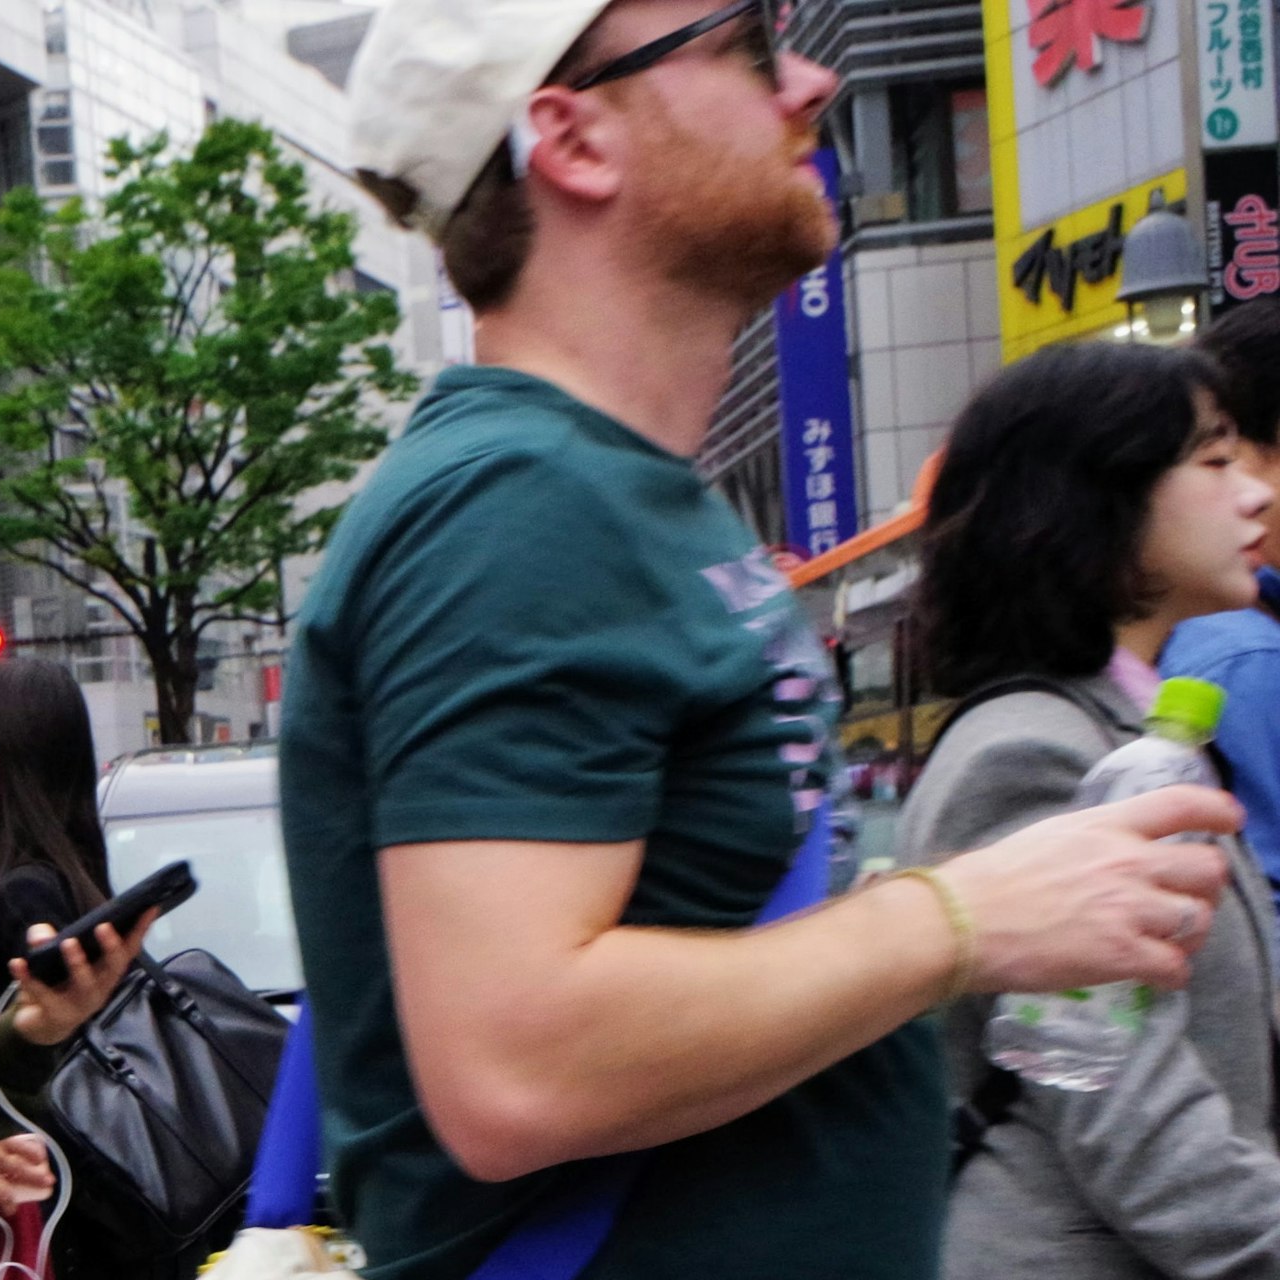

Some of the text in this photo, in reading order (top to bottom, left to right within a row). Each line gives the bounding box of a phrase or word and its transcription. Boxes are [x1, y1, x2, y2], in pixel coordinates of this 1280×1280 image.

[1207, 3, 1233, 101] フルーツ
[1239, 0, 1264, 89] 谷西村
[1223, 194, 1280, 301] HUB
